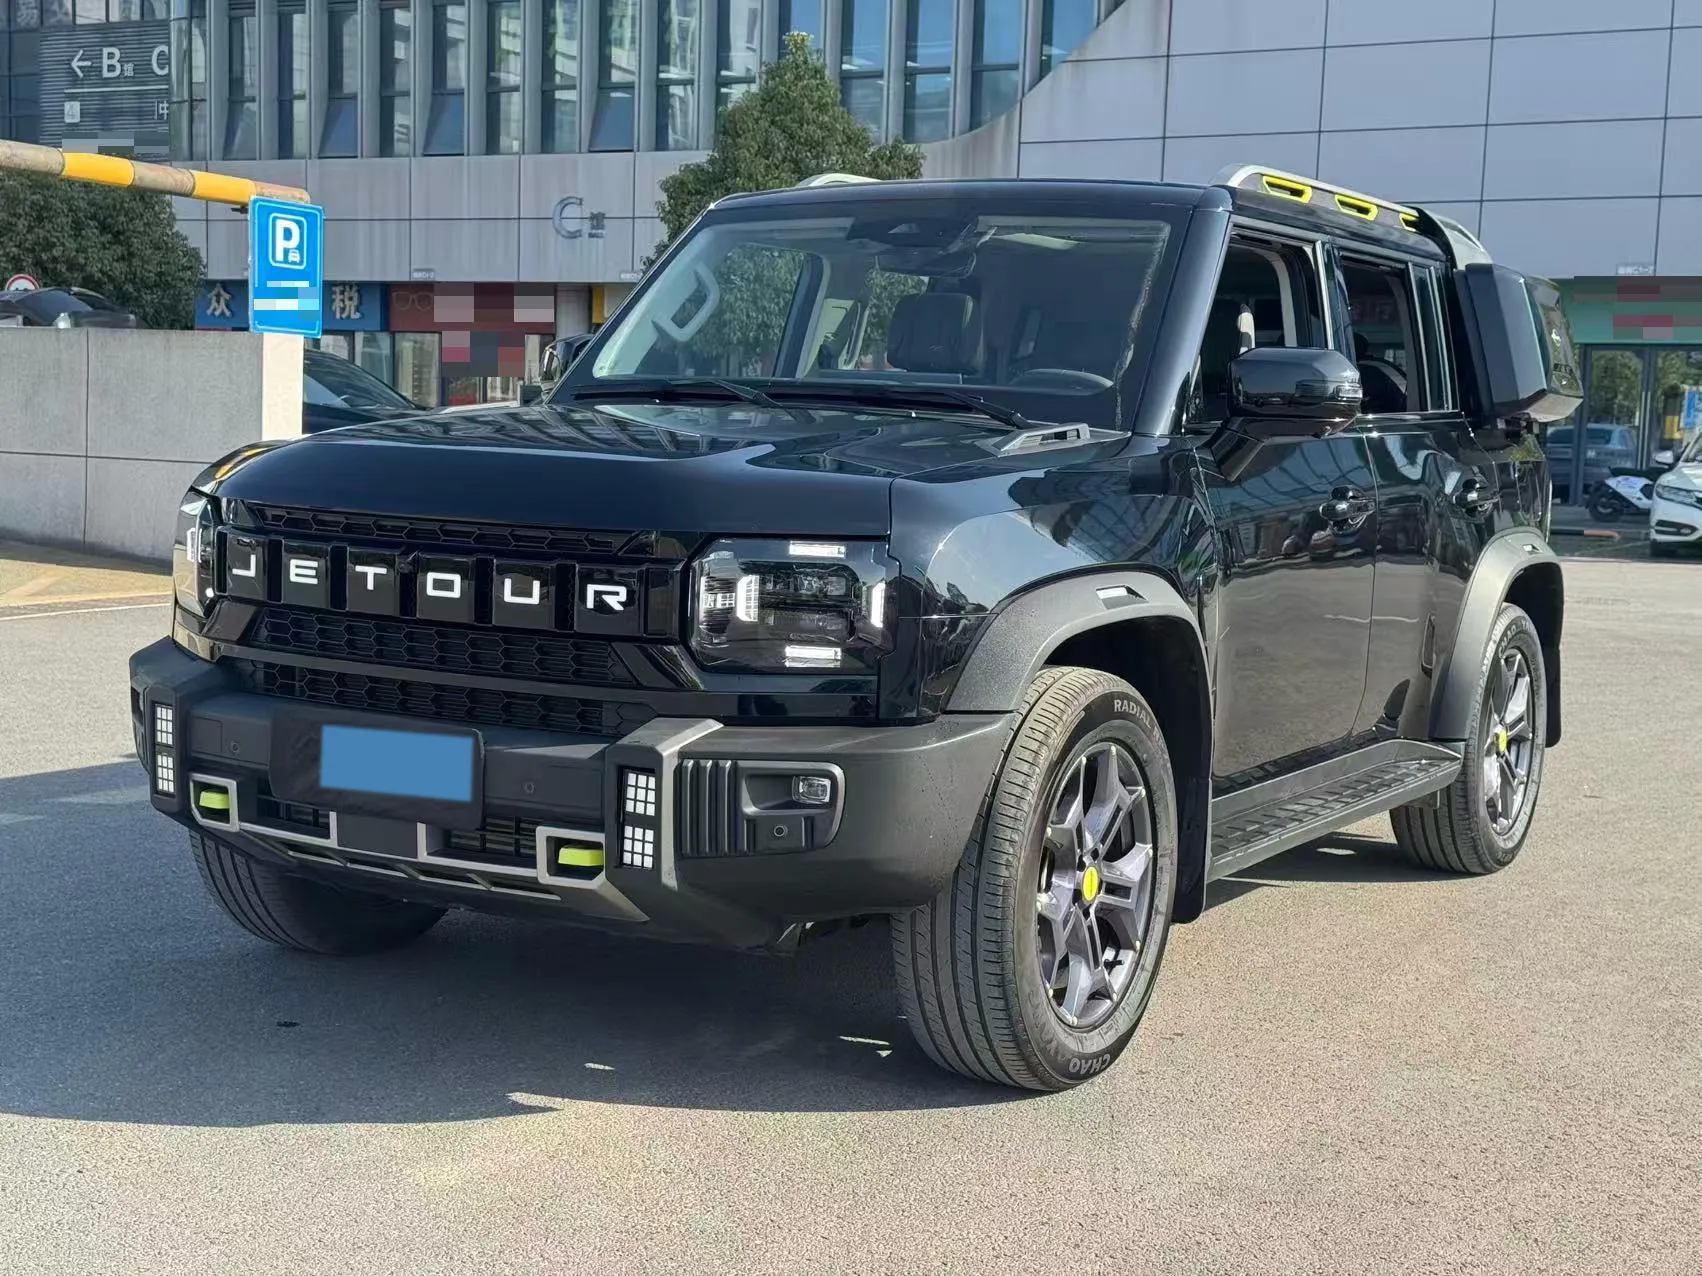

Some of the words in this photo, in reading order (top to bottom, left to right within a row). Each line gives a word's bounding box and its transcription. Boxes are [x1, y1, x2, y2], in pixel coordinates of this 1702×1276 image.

[275, 218, 300, 262] P
[206, 283, 232, 317] 众
[332, 284, 362, 320] 税
[231, 553, 627, 611] JETOUR
[1113, 699, 1152, 729] RADIAL
[1068, 1053, 1111, 1075] CHAO
